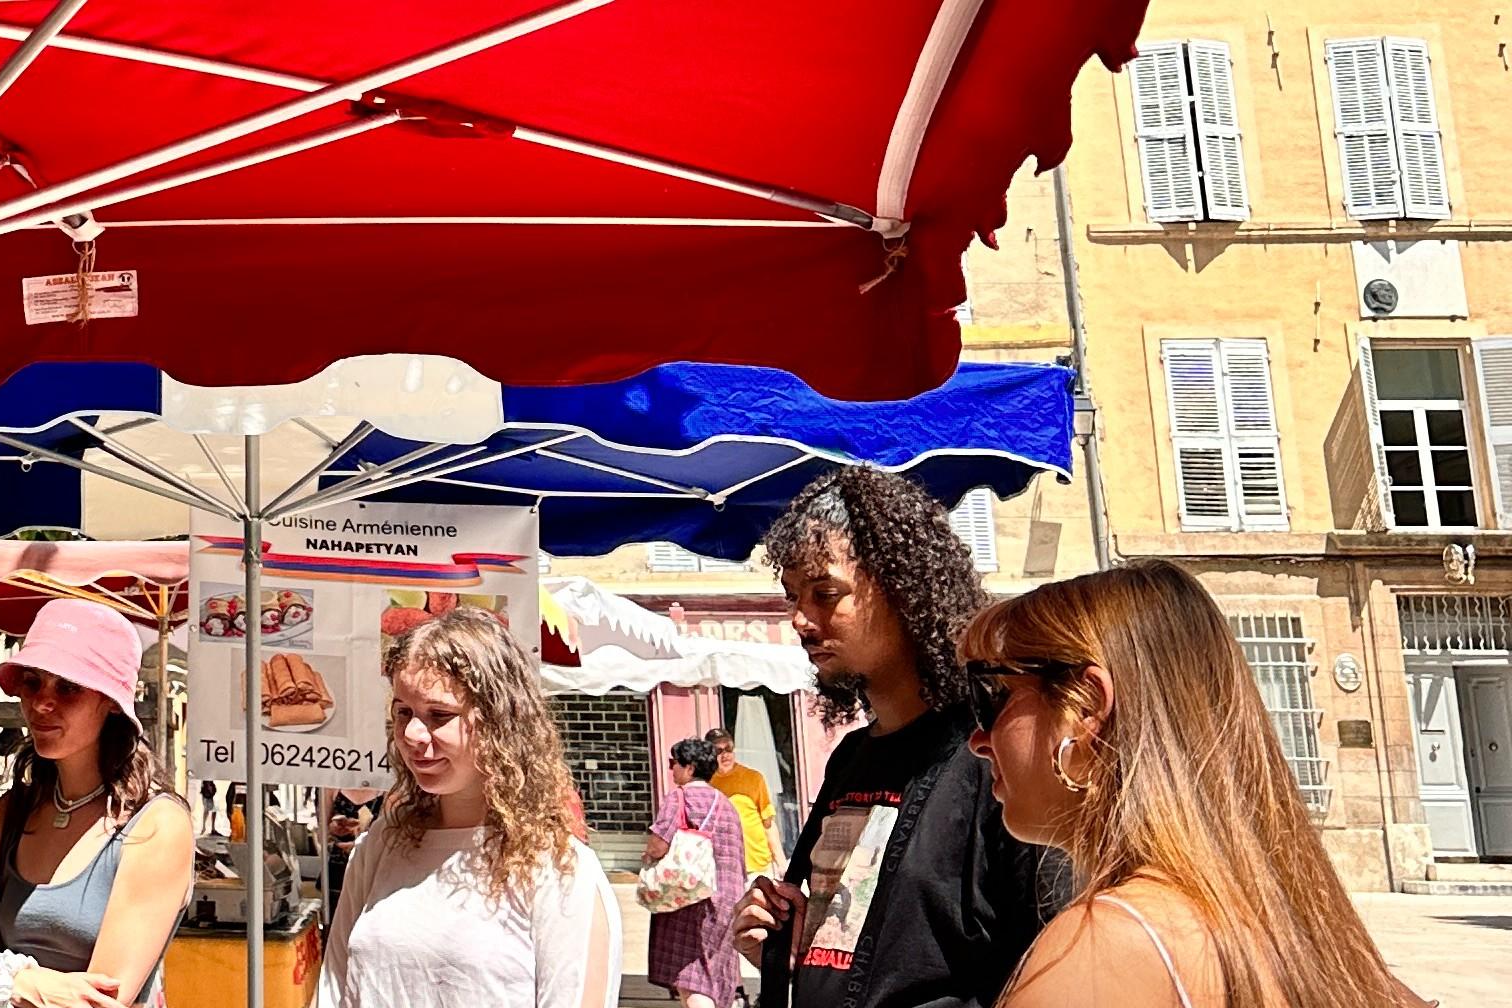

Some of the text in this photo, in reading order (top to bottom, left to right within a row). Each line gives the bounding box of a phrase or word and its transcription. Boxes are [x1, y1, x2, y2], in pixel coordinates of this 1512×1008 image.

[342, 518, 458, 538] Arménienne
[305, 538, 419, 557] NAHAPETYAN
[200, 740, 235, 764] Tel
